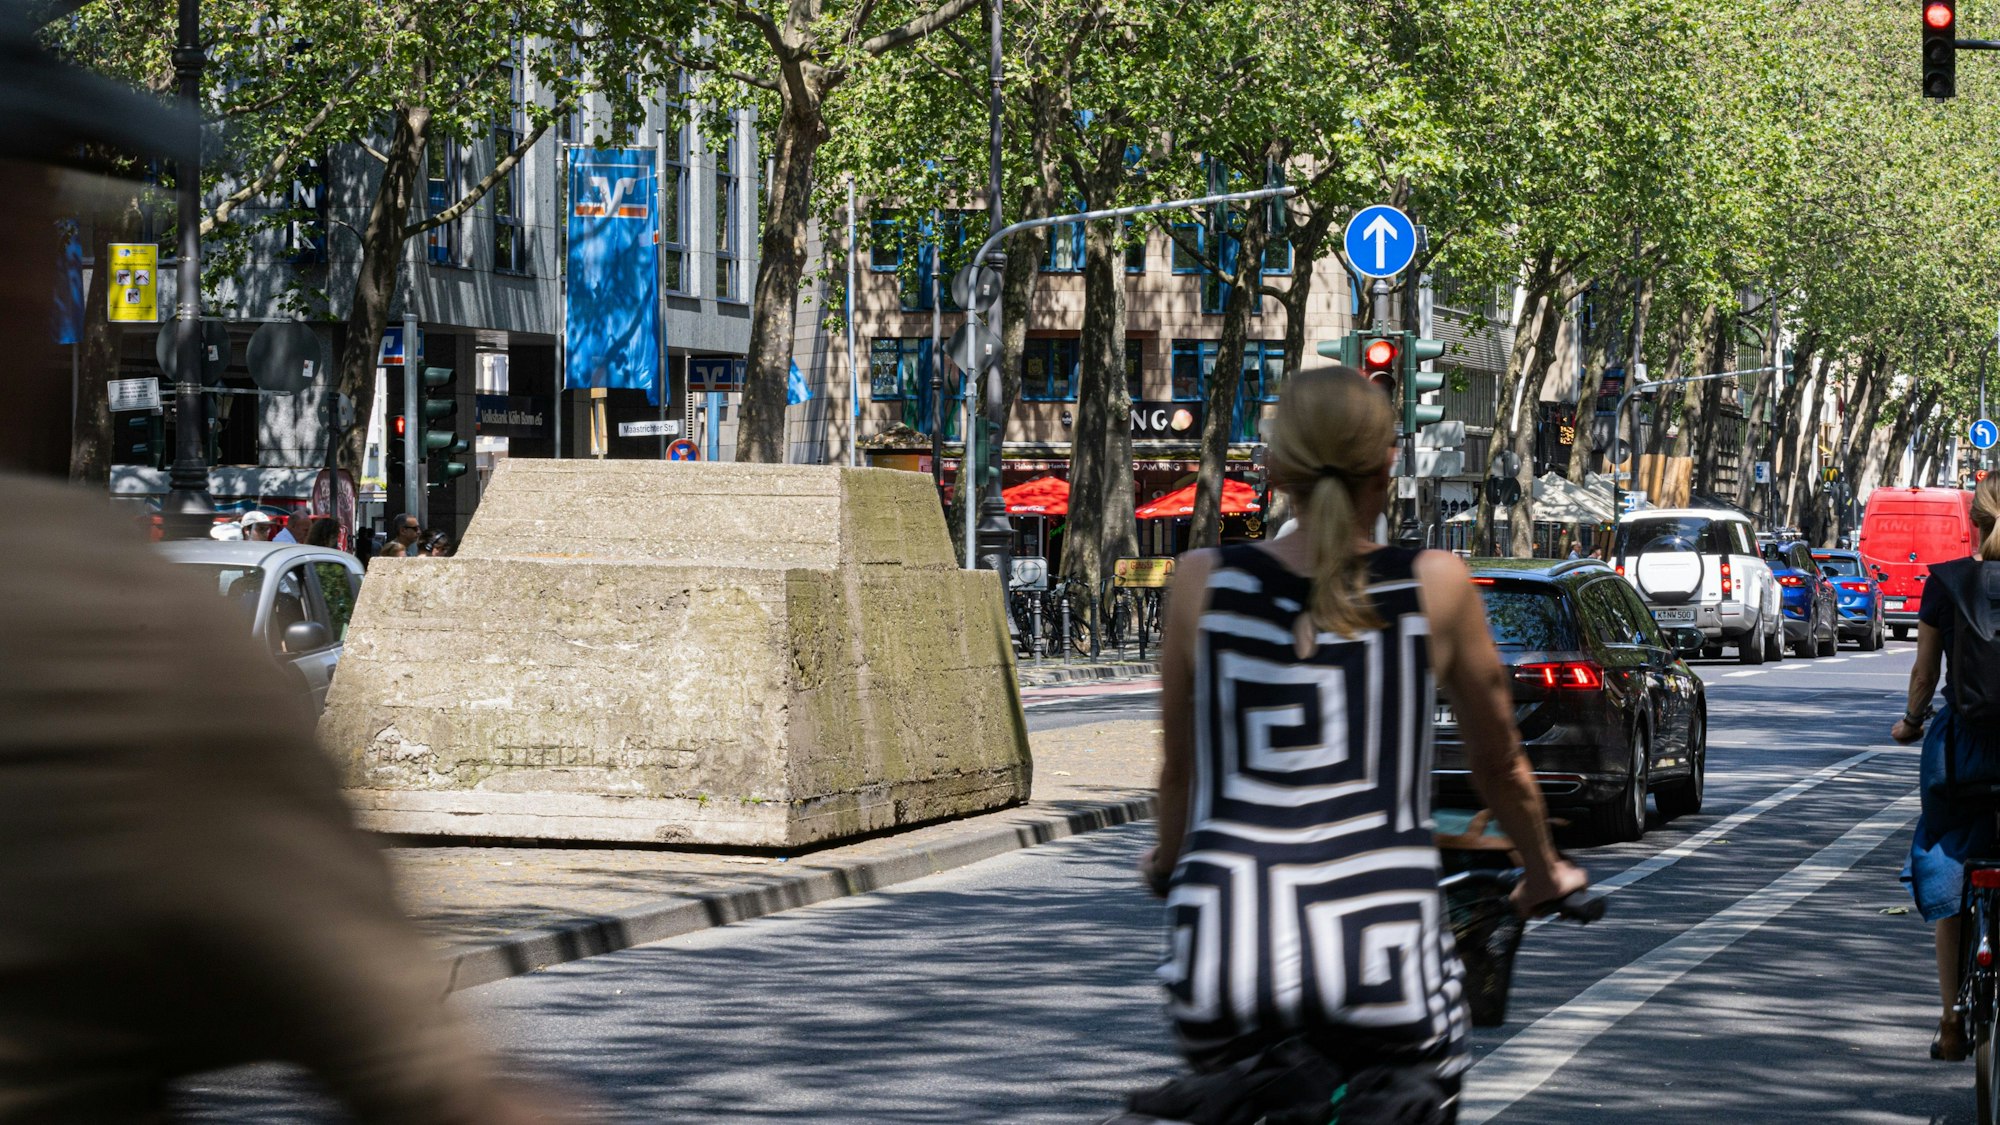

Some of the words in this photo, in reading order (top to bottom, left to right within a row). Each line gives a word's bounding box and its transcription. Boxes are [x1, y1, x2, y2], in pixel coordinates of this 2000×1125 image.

[481, 409, 508, 424] Volksbank
[508, 410, 521, 425] Köln
[521, 411, 535, 425] Bonn
[535, 412, 543, 426] eG
[623, 425, 663, 433] Maastrichter
[664, 423, 675, 432] Str.
[1142, 463, 1158, 471] AM
[1159, 463, 1181, 471] RING
[1657, 611, 1663, 619] K
[1677, 611, 1691, 619] 500
